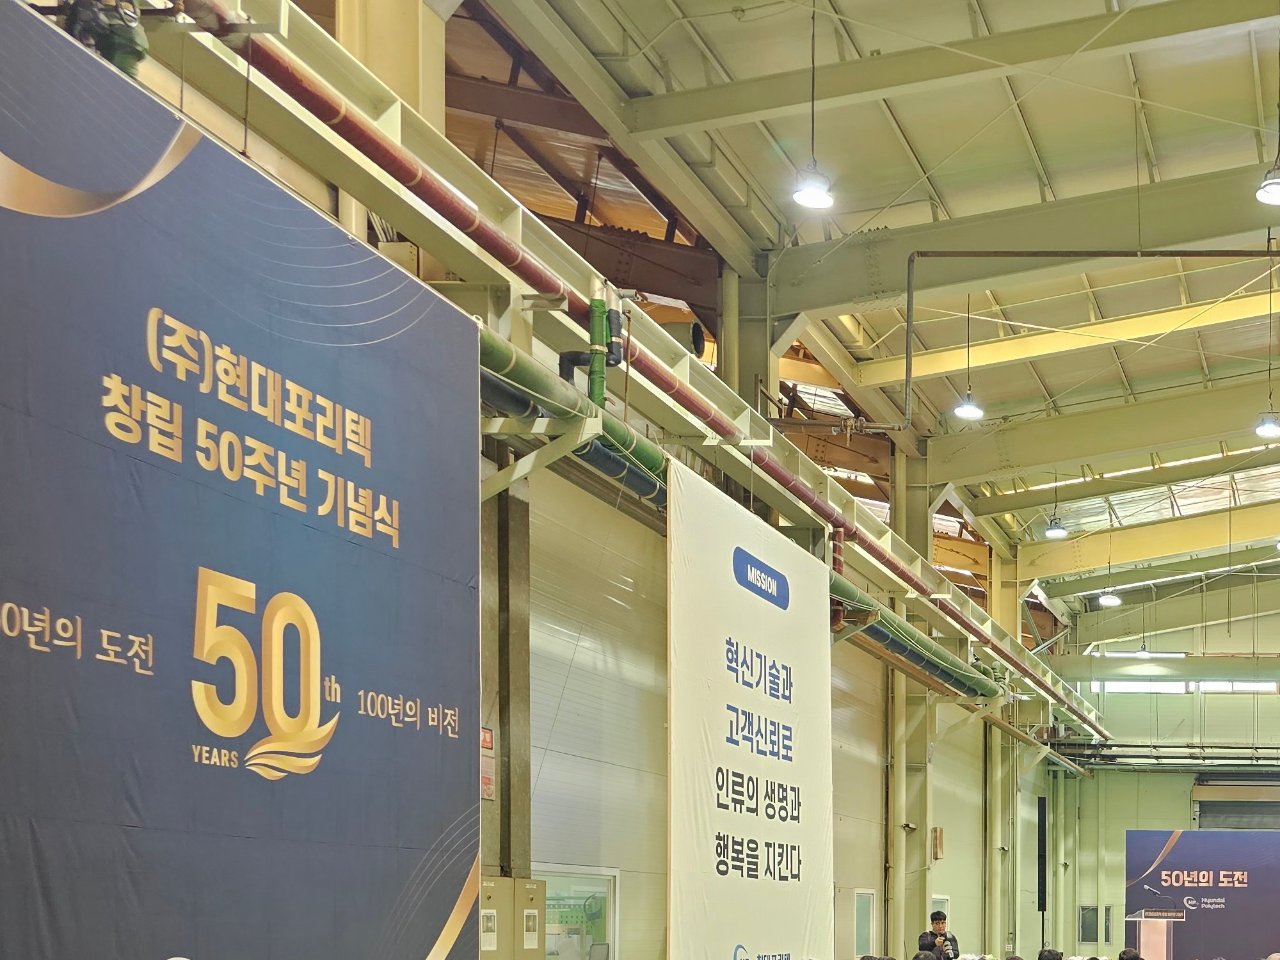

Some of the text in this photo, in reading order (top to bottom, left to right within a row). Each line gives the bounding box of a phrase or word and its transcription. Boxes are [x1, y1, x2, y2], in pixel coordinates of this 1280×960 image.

[147, 307, 372, 468] (주)현대포리텍
[101, 373, 399, 548] 창립 50주년 기념식
[747, 564, 777, 597] MISSION
[0, 602, 154, 676] 0년의 도전
[725, 637, 793, 704] 혁신기술과
[358, 689, 421, 732] 100년의
[428, 704, 459, 740] 비전
[725, 703, 793, 762] 고객신뢰로
[192, 744, 239, 769] YEARS
[715, 766, 801, 823] 인류의 생명과
[715, 832, 801, 882] 행복을 지킨다
[1160, 870, 1248, 888] 50년의 도전
